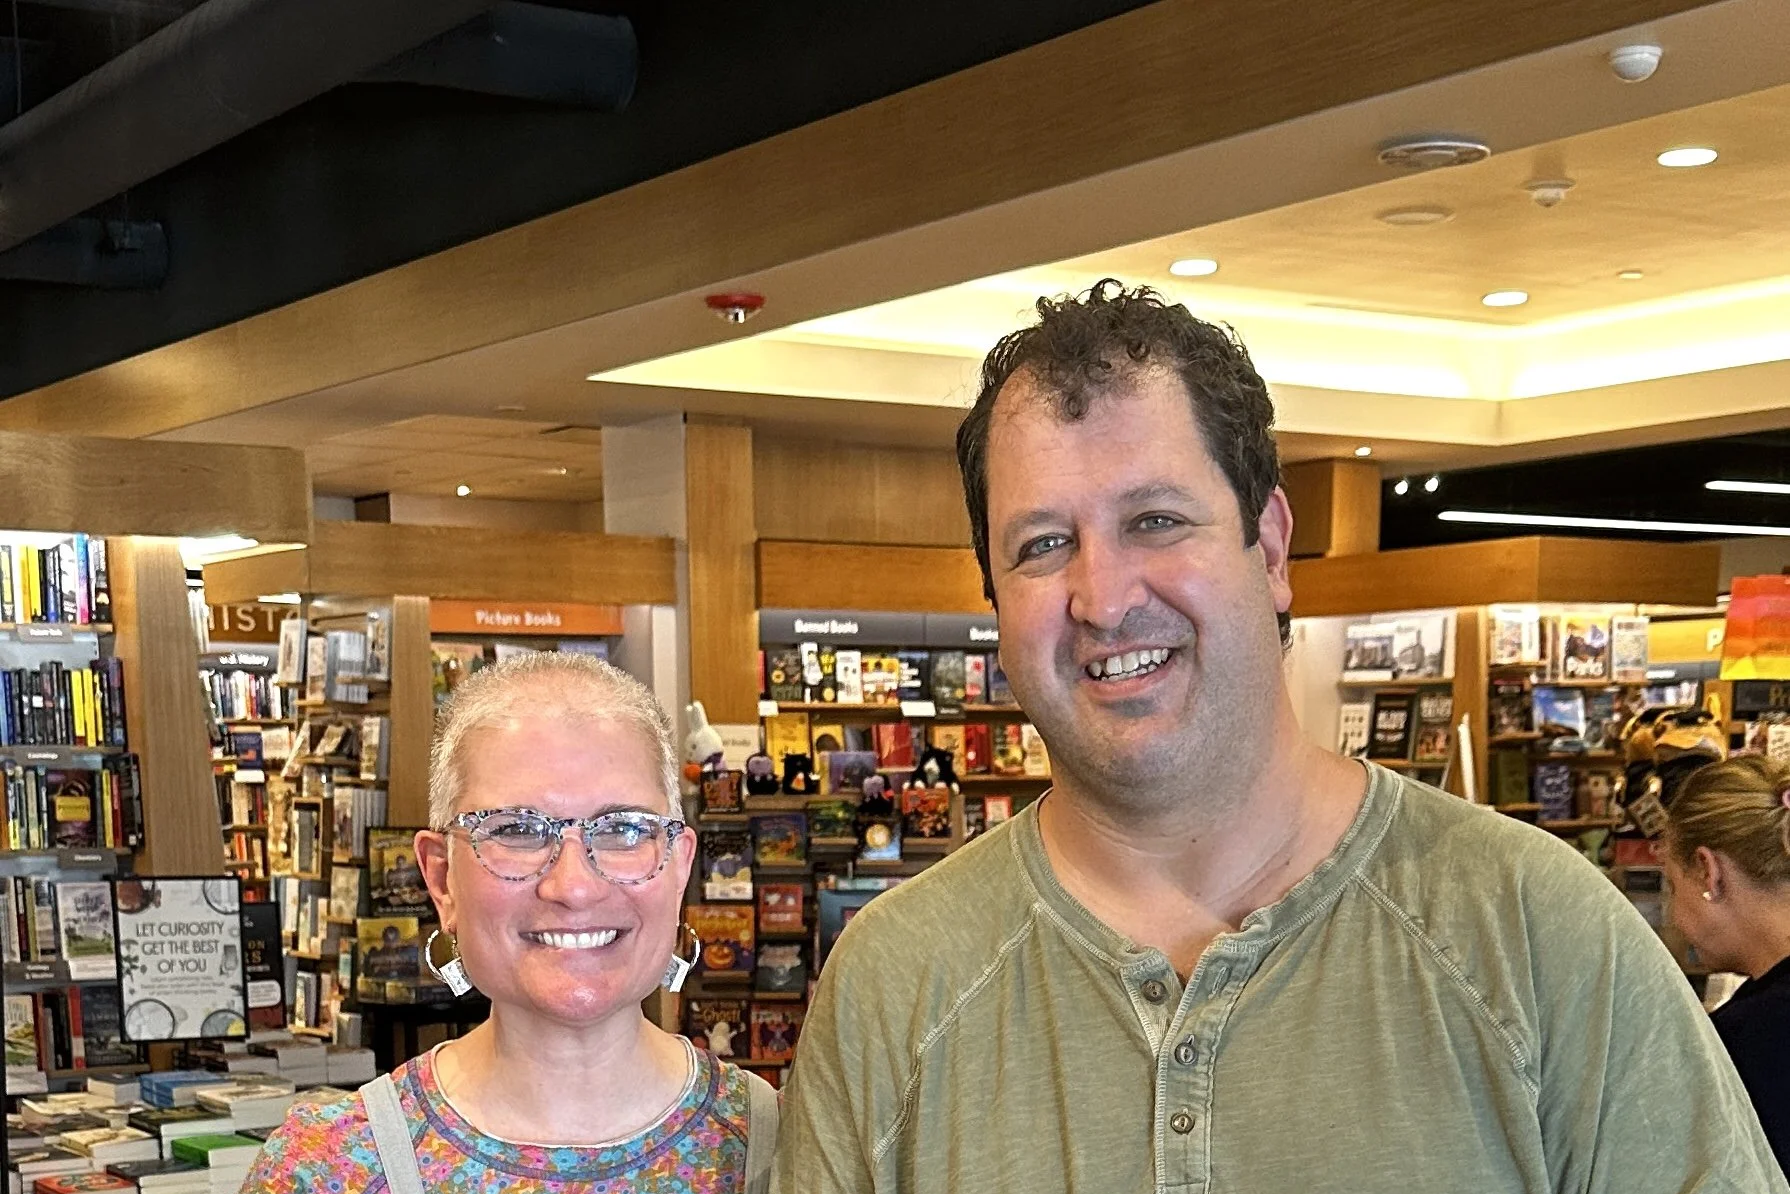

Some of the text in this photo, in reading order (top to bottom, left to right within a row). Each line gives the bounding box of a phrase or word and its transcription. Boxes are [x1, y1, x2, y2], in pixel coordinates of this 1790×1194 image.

[475, 610, 561, 627] Picture Books
[830, 619, 858, 634] Books
[135, 921, 225, 937] LET CURIOSITY
[141, 939, 220, 956] GET THE BEST
[157, 958, 207, 974] OF YOU
